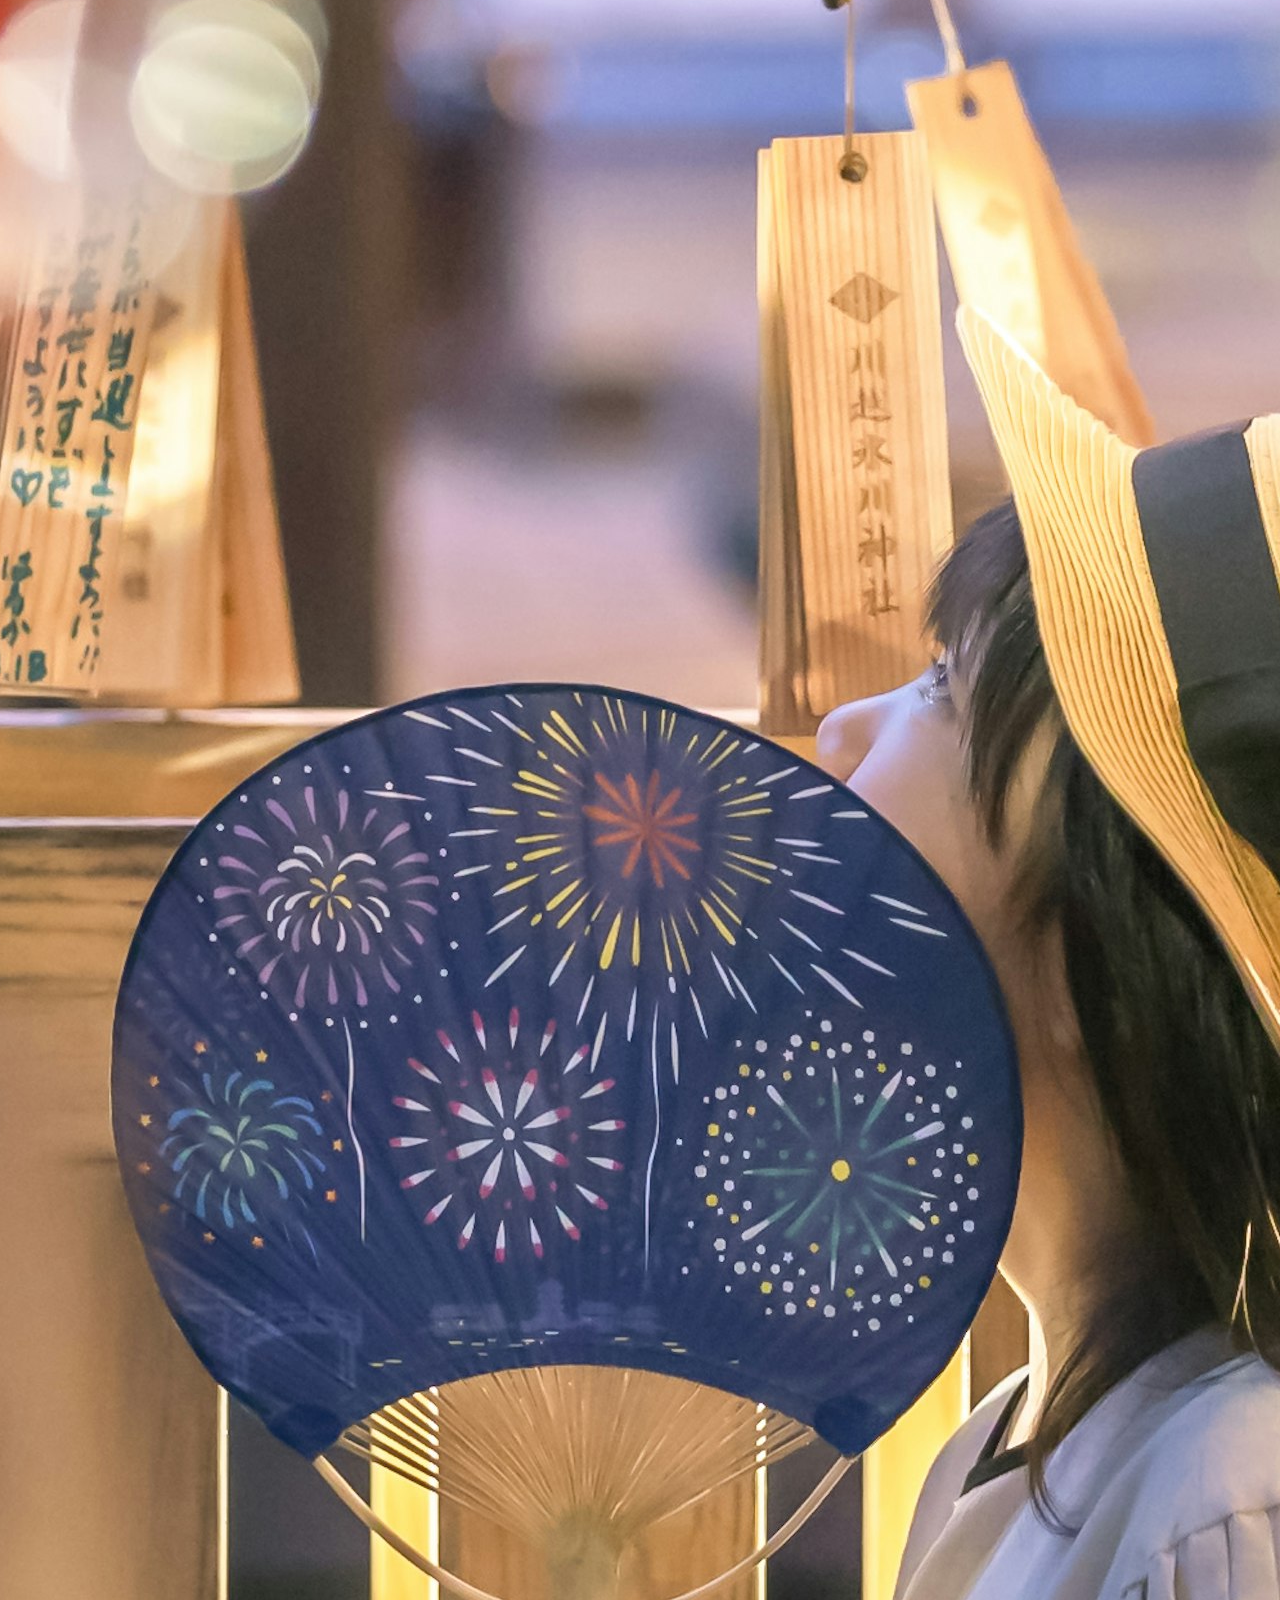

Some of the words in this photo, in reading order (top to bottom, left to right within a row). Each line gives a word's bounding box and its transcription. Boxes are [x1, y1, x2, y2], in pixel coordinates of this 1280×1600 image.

[849, 340, 900, 617] 川越氷川神社
